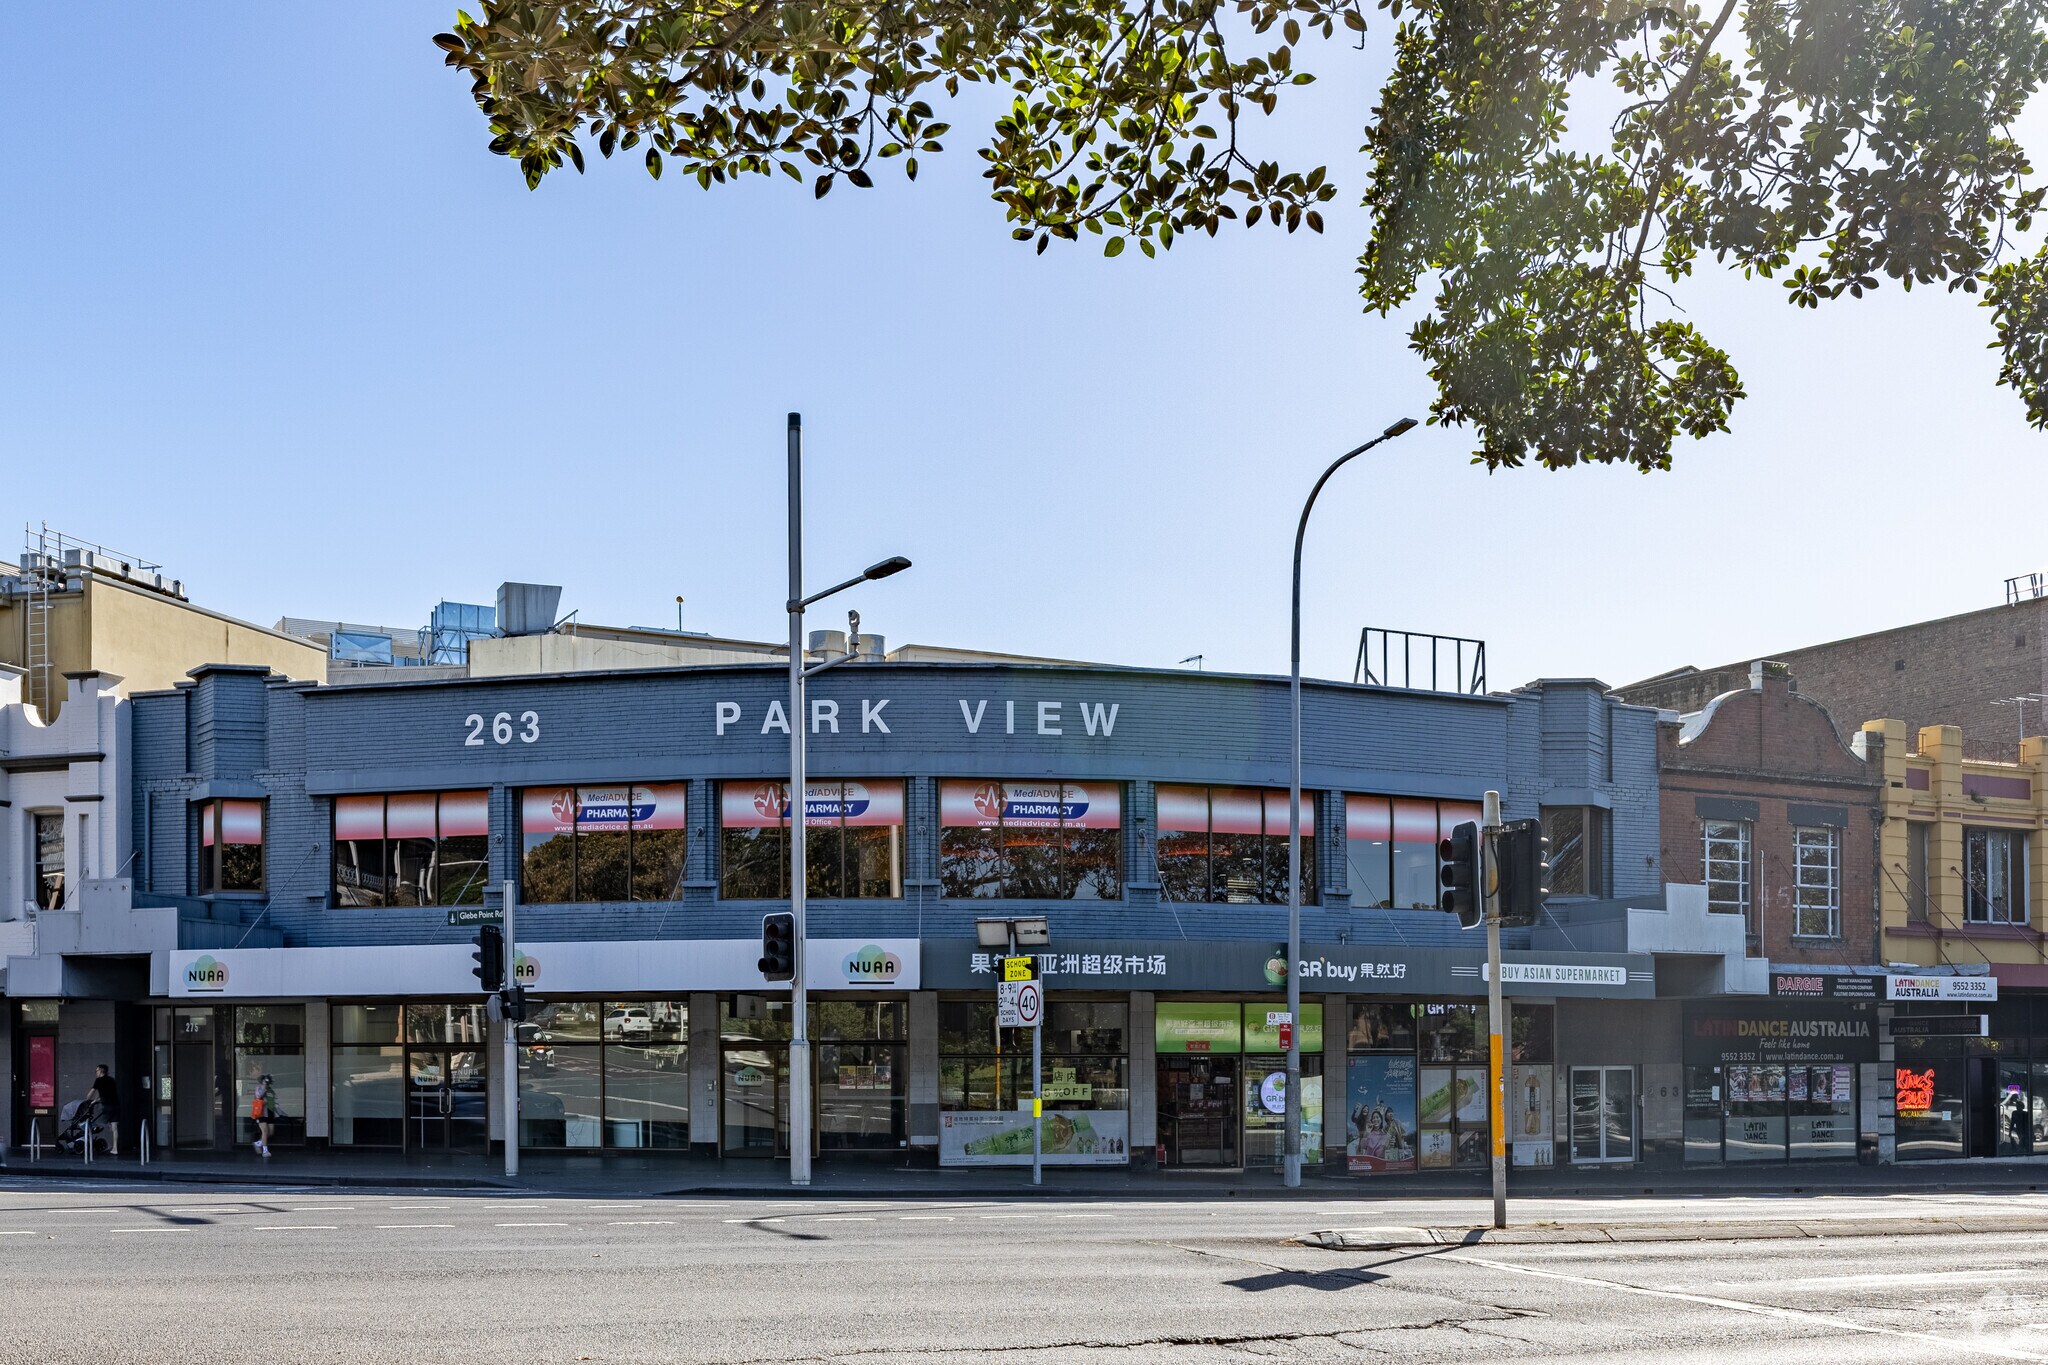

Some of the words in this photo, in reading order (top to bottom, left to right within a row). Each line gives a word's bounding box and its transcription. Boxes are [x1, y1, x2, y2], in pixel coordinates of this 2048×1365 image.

[716, 699, 891, 736] PARK
[959, 699, 1120, 737] VIEW
[465, 710, 540, 746] 263
[804, 804, 854, 813] HARMACY
[1013, 805, 1073, 815] PHARMACY
[460, 912, 478, 920] Glebe
[478, 911, 494, 919] Point
[495, 910, 503, 918] Rd
[849, 961, 894, 973] NUAA
[1360, 963, 1406, 978] 果然好
[188, 970, 224, 981] NUAA
[1502, 966, 1520, 979] BUY
[1524, 967, 1551, 980] ASIAN
[1555, 968, 1620, 982] SUPERMARKET
[1777, 976, 1823, 991] DARGIE
[1953, 982, 1969, 990] 9552
[1970, 982, 1986, 991] 3352
[1895, 988, 1939, 997] AUSTRALIA
[1022, 995, 1036, 1011] 40
[185, 1022, 199, 1032] 275
[1760, 1038, 1777, 1048] Feels
[1778, 1038, 1790, 1048] like
[1793, 1038, 1810, 1048] home
[1721, 1052, 1737, 1060] 9552
[1740, 1052, 1755, 1060] 3352
[1765, 1051, 1844, 1061] www.latindance.com.au
[1647, 1086, 1679, 1097] 263
[1743, 1121, 1767, 1131] LATIN
[1811, 1120, 1835, 1129] LATIN
[1744, 1132, 1767, 1140] DANCE
[1811, 1130, 1834, 1138] DANCE
